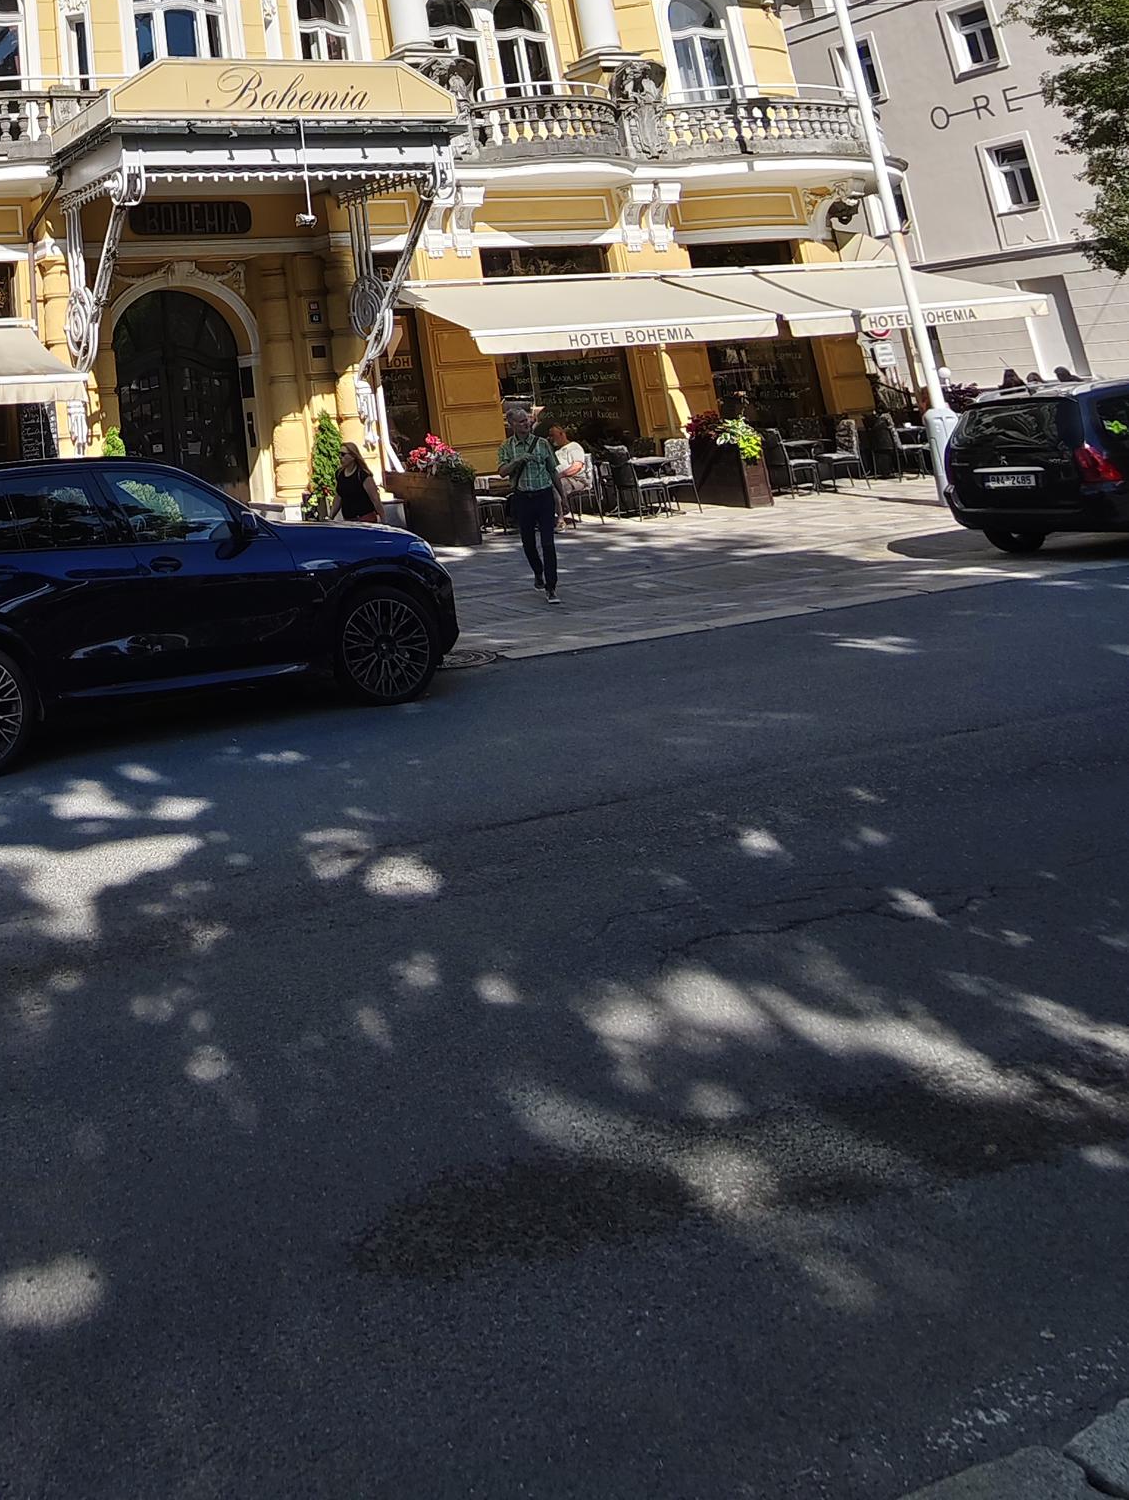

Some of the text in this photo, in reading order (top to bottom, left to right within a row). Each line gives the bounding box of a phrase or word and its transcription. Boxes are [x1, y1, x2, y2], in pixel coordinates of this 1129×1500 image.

[205, 66, 371, 111] Bohemia
[145, 203, 240, 233] BOHEMIA
[869, 308, 977, 328] HOTEL OHEMIA
[569, 327, 694, 347] HOTEL BOHEMIA
